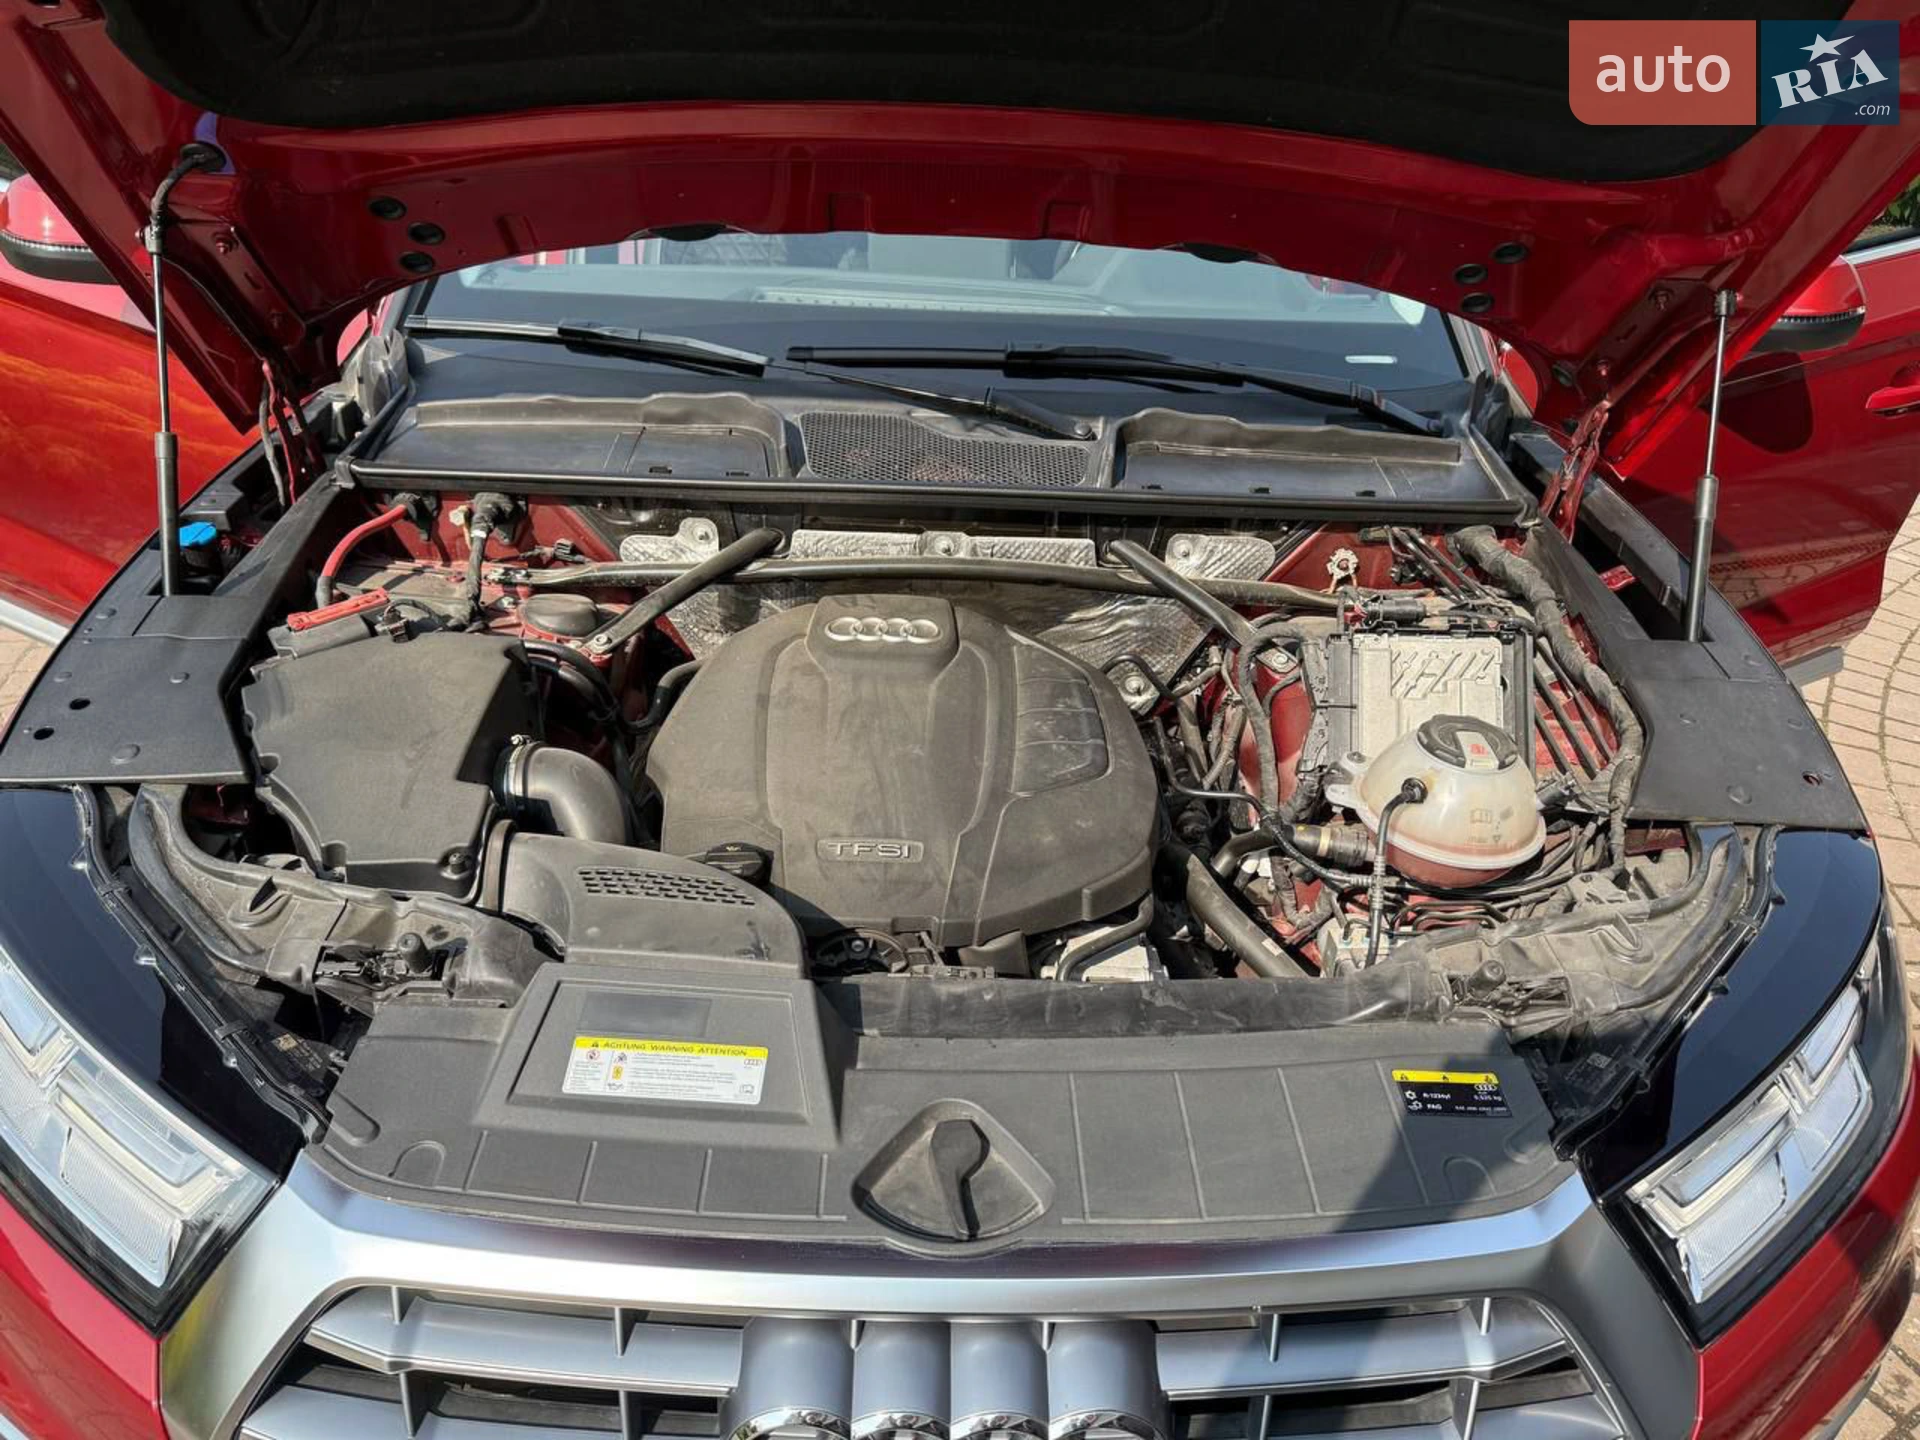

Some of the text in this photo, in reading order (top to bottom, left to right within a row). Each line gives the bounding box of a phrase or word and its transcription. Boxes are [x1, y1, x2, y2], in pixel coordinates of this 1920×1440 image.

[827, 842, 911, 859] TFSI
[603, 1042, 748, 1057] ACHTUNG WARNING ATTENTION
